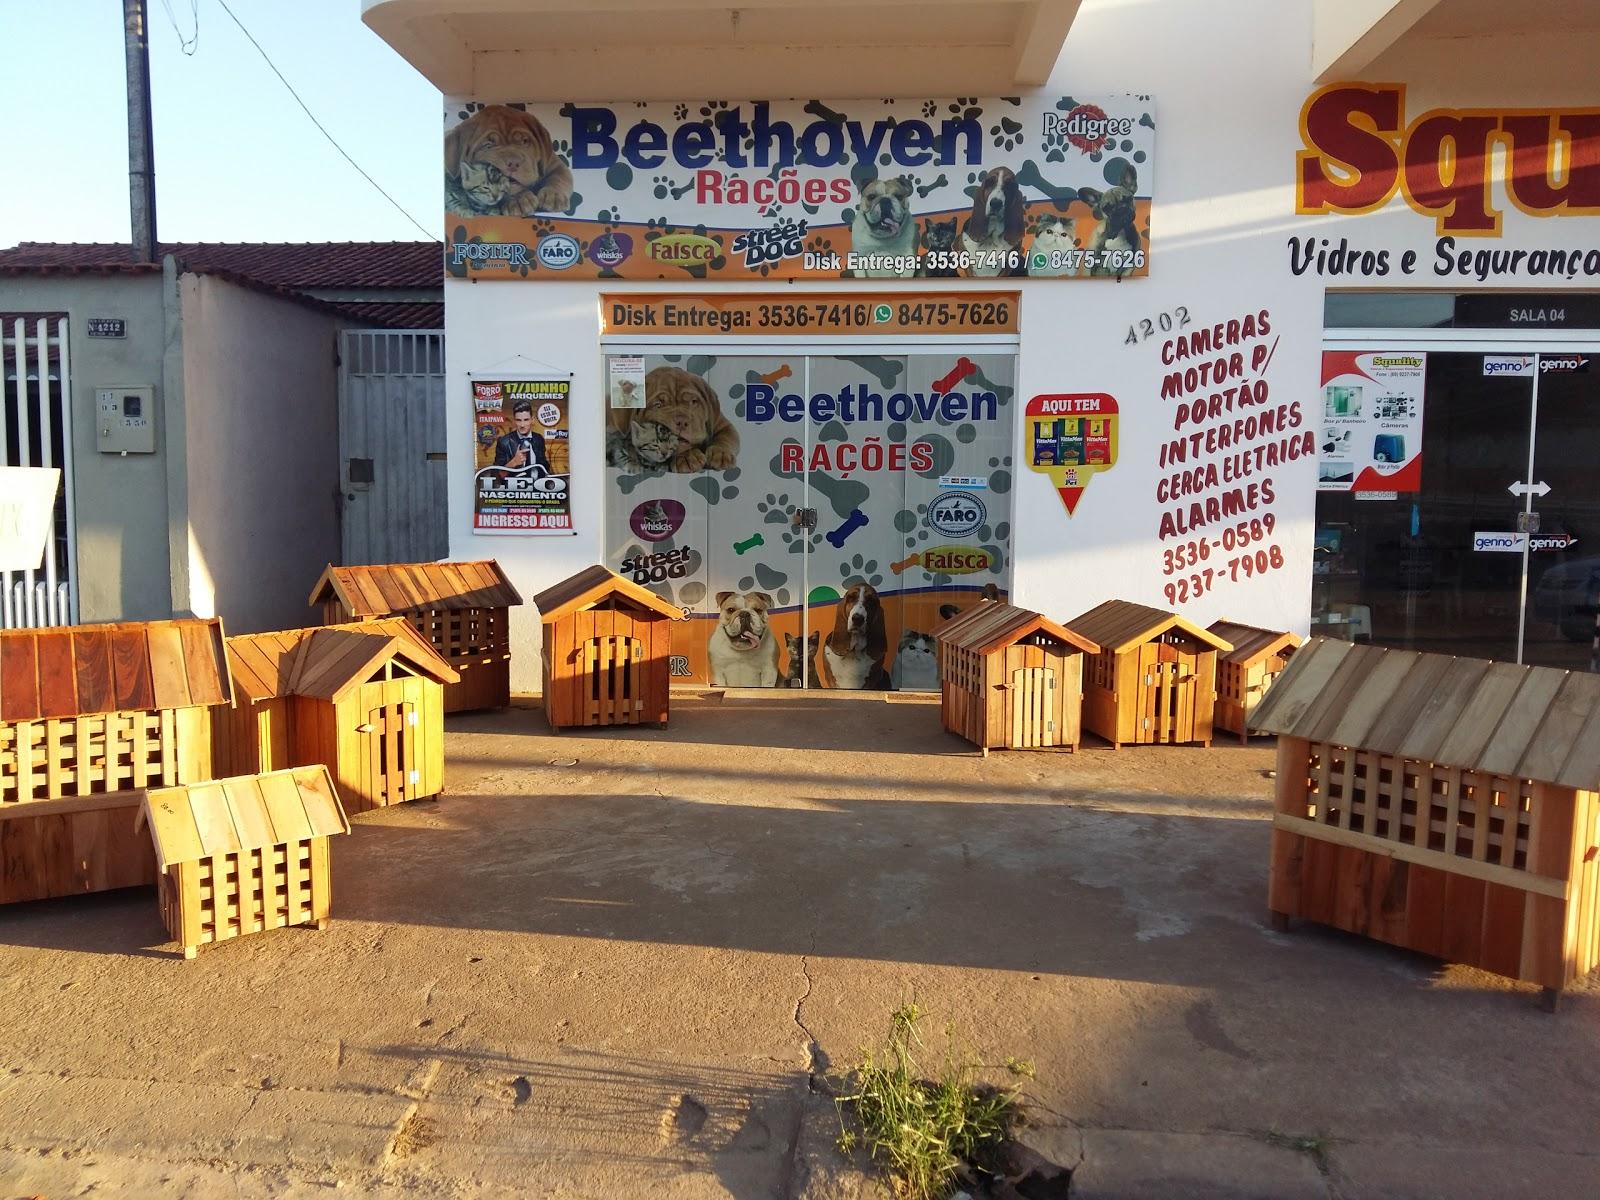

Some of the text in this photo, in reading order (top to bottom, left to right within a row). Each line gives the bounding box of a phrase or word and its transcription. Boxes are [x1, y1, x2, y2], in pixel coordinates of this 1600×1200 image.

[571, 100, 983, 169] Beethoven
[1042, 112, 1132, 141] Pedigree
[696, 170, 852, 214] Rações
[733, 219, 809, 252] street
[452, 243, 530, 265] FOSTER
[543, 248, 573, 258] FARO
[651, 242, 717, 260] Faísca
[746, 237, 801, 266] DOG
[803, 252, 841, 270] Disk
[847, 252, 921, 274] Entrega:
[926, 250, 1019, 269] 3536-7416
[1050, 250, 1145, 269] 8475-7626
[1287, 235, 1600, 282] Vidros e Segurança
[612, 304, 656, 327] Disk
[663, 304, 751, 332] Entrega:
[897, 302, 1009, 325] 8475-7626
[1510, 309, 1565, 322] SALA 04
[1161, 309, 1271, 365] CAMERAS
[1160, 334, 1281, 401] MOTOR P/
[1372, 357, 1423, 368] Squality
[1485, 362, 1522, 374] genno
[1539, 360, 1577, 373] genno
[746, 383, 998, 422] Beethoven
[1041, 399, 1101, 414] AQUI TEM
[1174, 379, 1269, 431] PORTÃO
[1159, 401, 1303, 469] INTERFONES
[781, 436, 934, 479] RAÇÕES
[1157, 431, 1316, 503] CERCA ELETRICA
[479, 491, 567, 500] NASCIMENTO
[480, 476, 566, 492] LEO
[478, 514, 569, 528] INGRESSO AQUI
[936, 510, 977, 522] FARO
[1159, 478, 1275, 541] ALARMES
[640, 521, 673, 531] whiskas
[1162, 512, 1276, 576] 3536-0589
[1476, 538, 1513, 549] genno
[1529, 539, 1567, 551] genno
[620, 545, 691, 574] street
[633, 560, 687, 586] DOG
[924, 551, 989, 569] Faísca
[1163, 545, 1284, 605] 9237-7908
